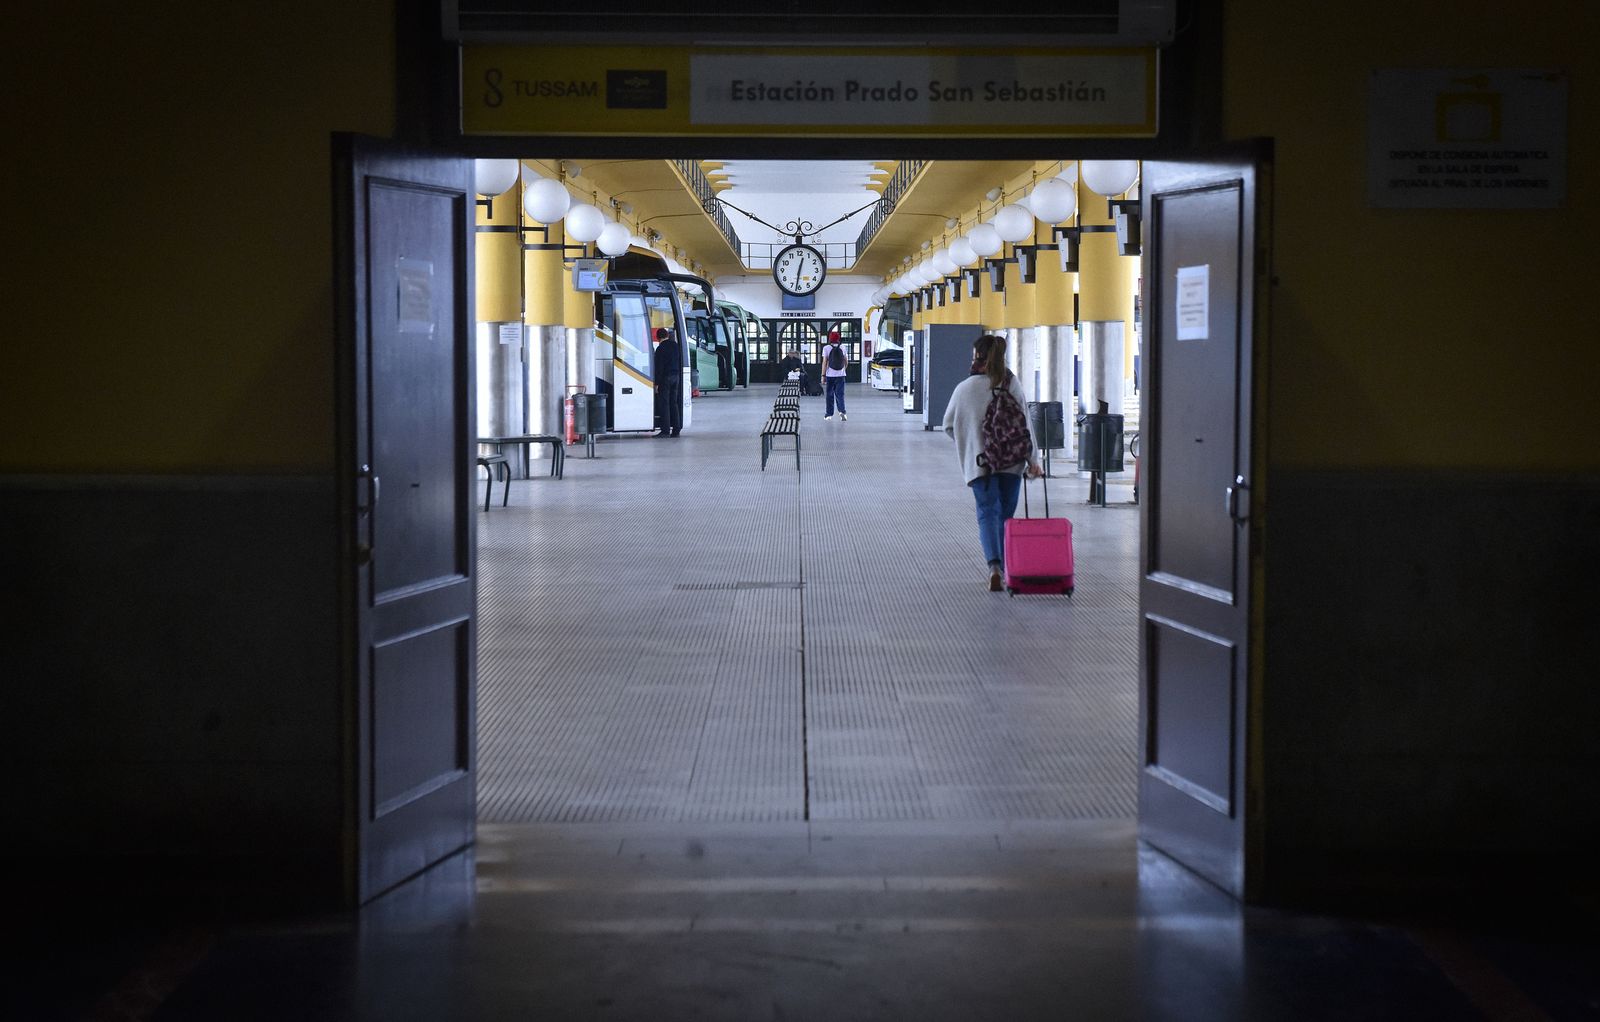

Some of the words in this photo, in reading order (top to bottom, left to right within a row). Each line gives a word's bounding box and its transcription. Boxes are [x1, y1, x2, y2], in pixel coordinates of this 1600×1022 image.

[512, 80, 599, 97] TUSSAM
[731, 80, 834, 102] Estación
[845, 80, 919, 102] Prado
[928, 80, 974, 102] San
[983, 80, 1108, 102] Sebastián
